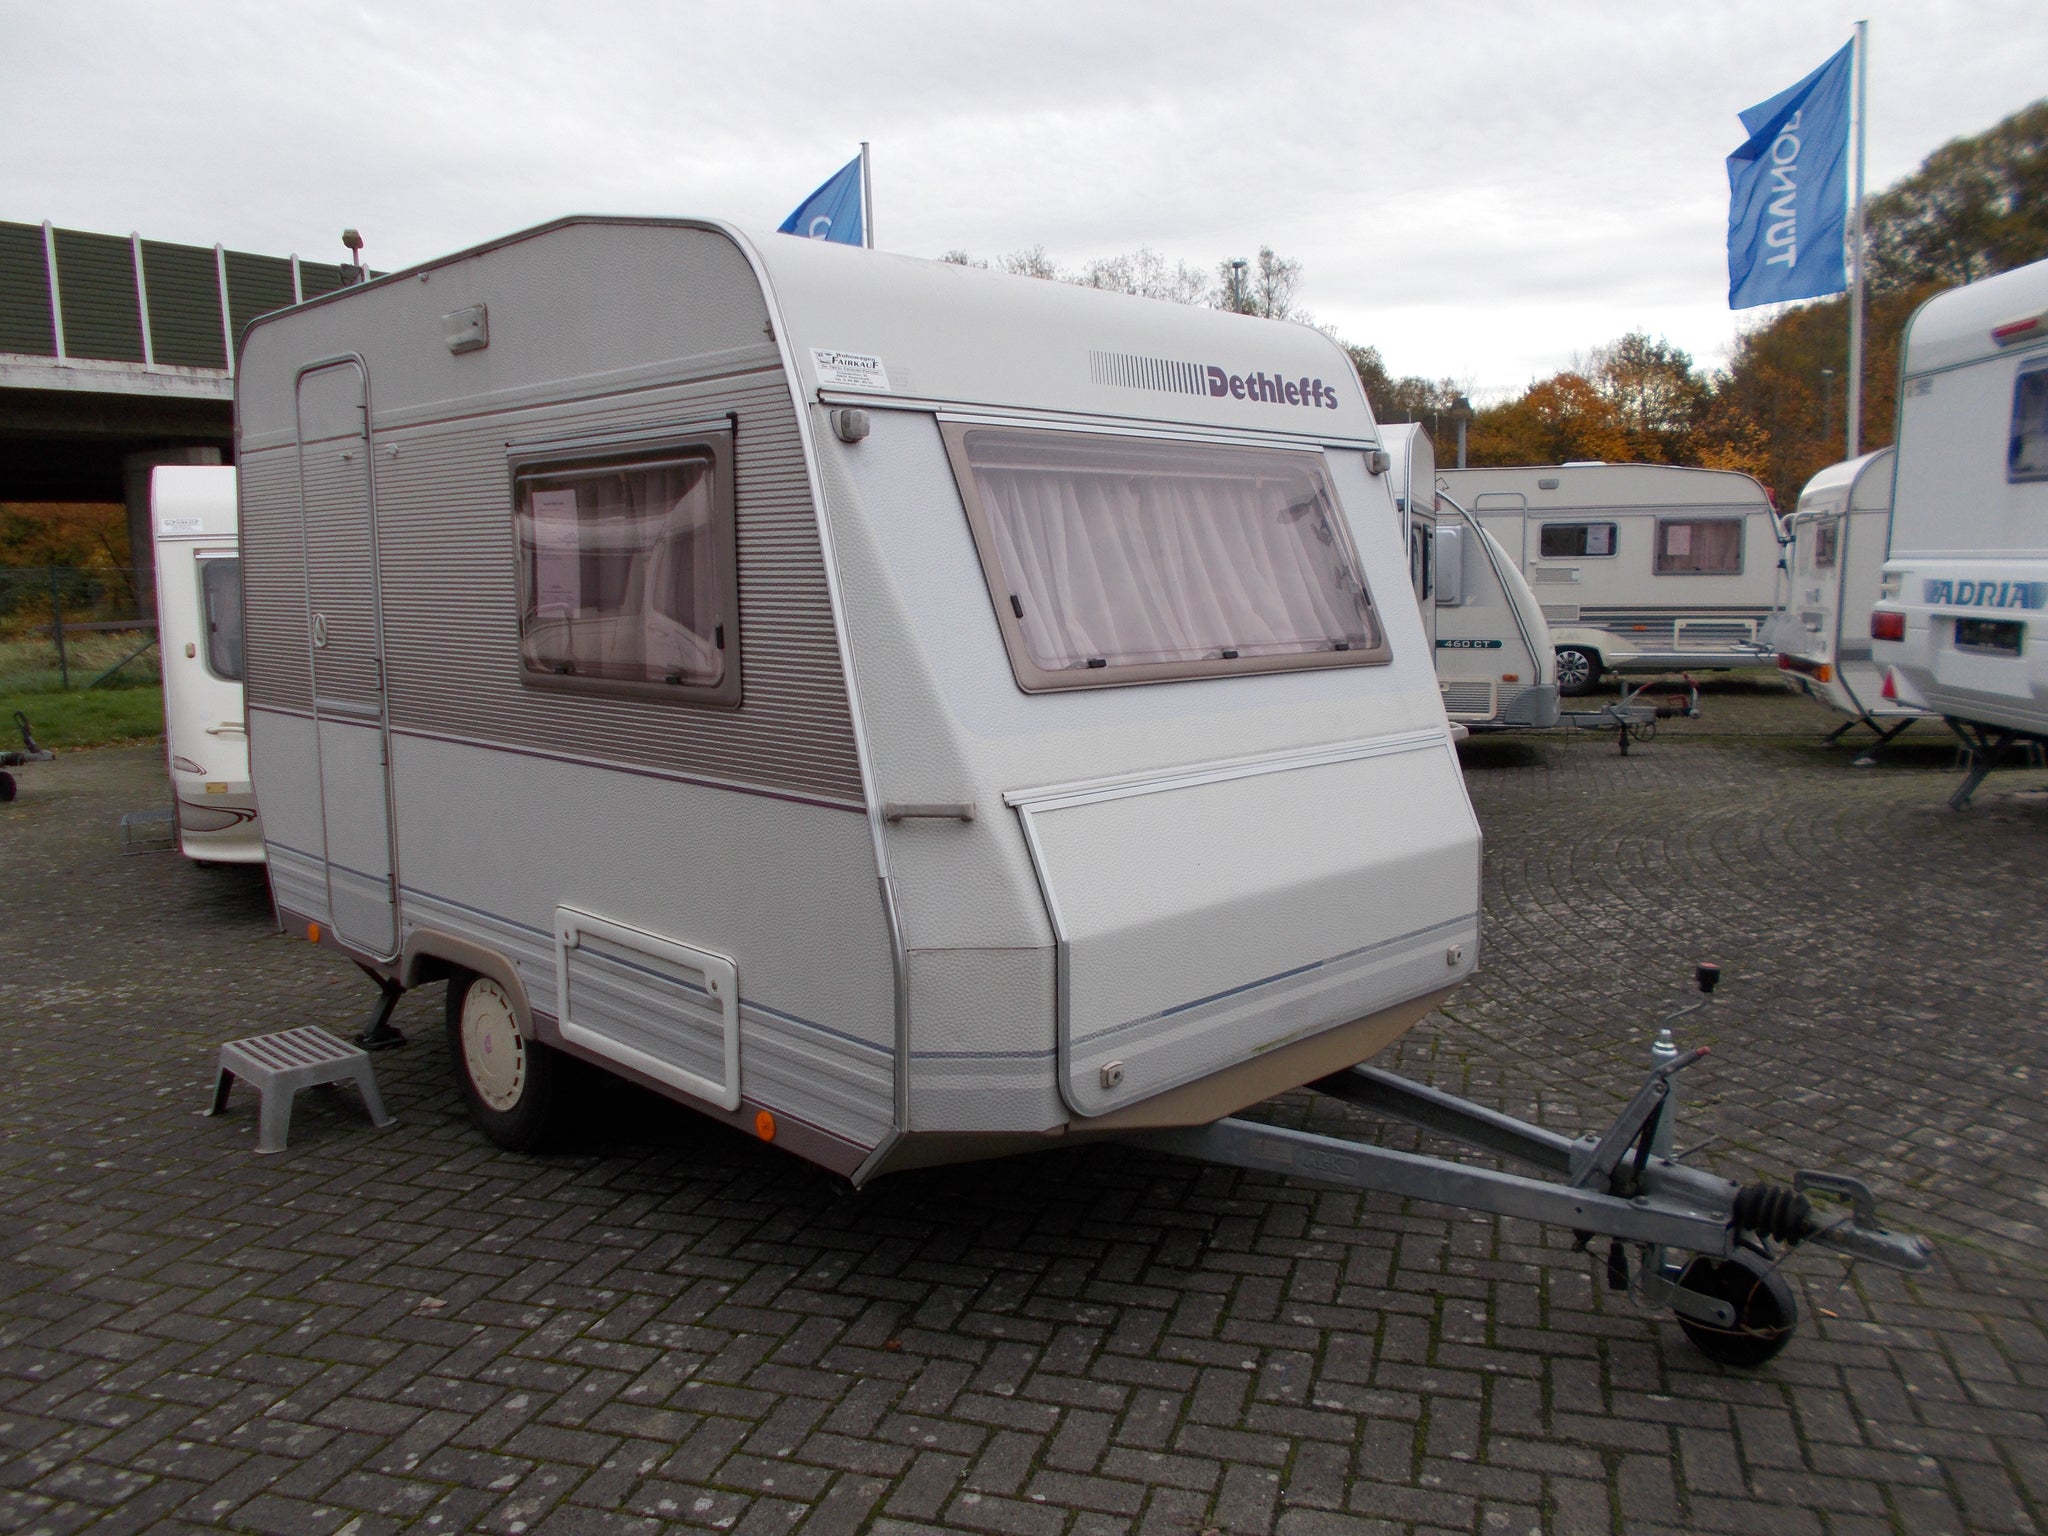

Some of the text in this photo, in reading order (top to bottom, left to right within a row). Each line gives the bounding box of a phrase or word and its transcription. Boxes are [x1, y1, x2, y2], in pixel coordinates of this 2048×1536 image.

[832, 356, 879, 369] FAIRKAUF
[1207, 366, 1338, 409] Dethleffs
[1933, 579, 2031, 609] ADRIA
